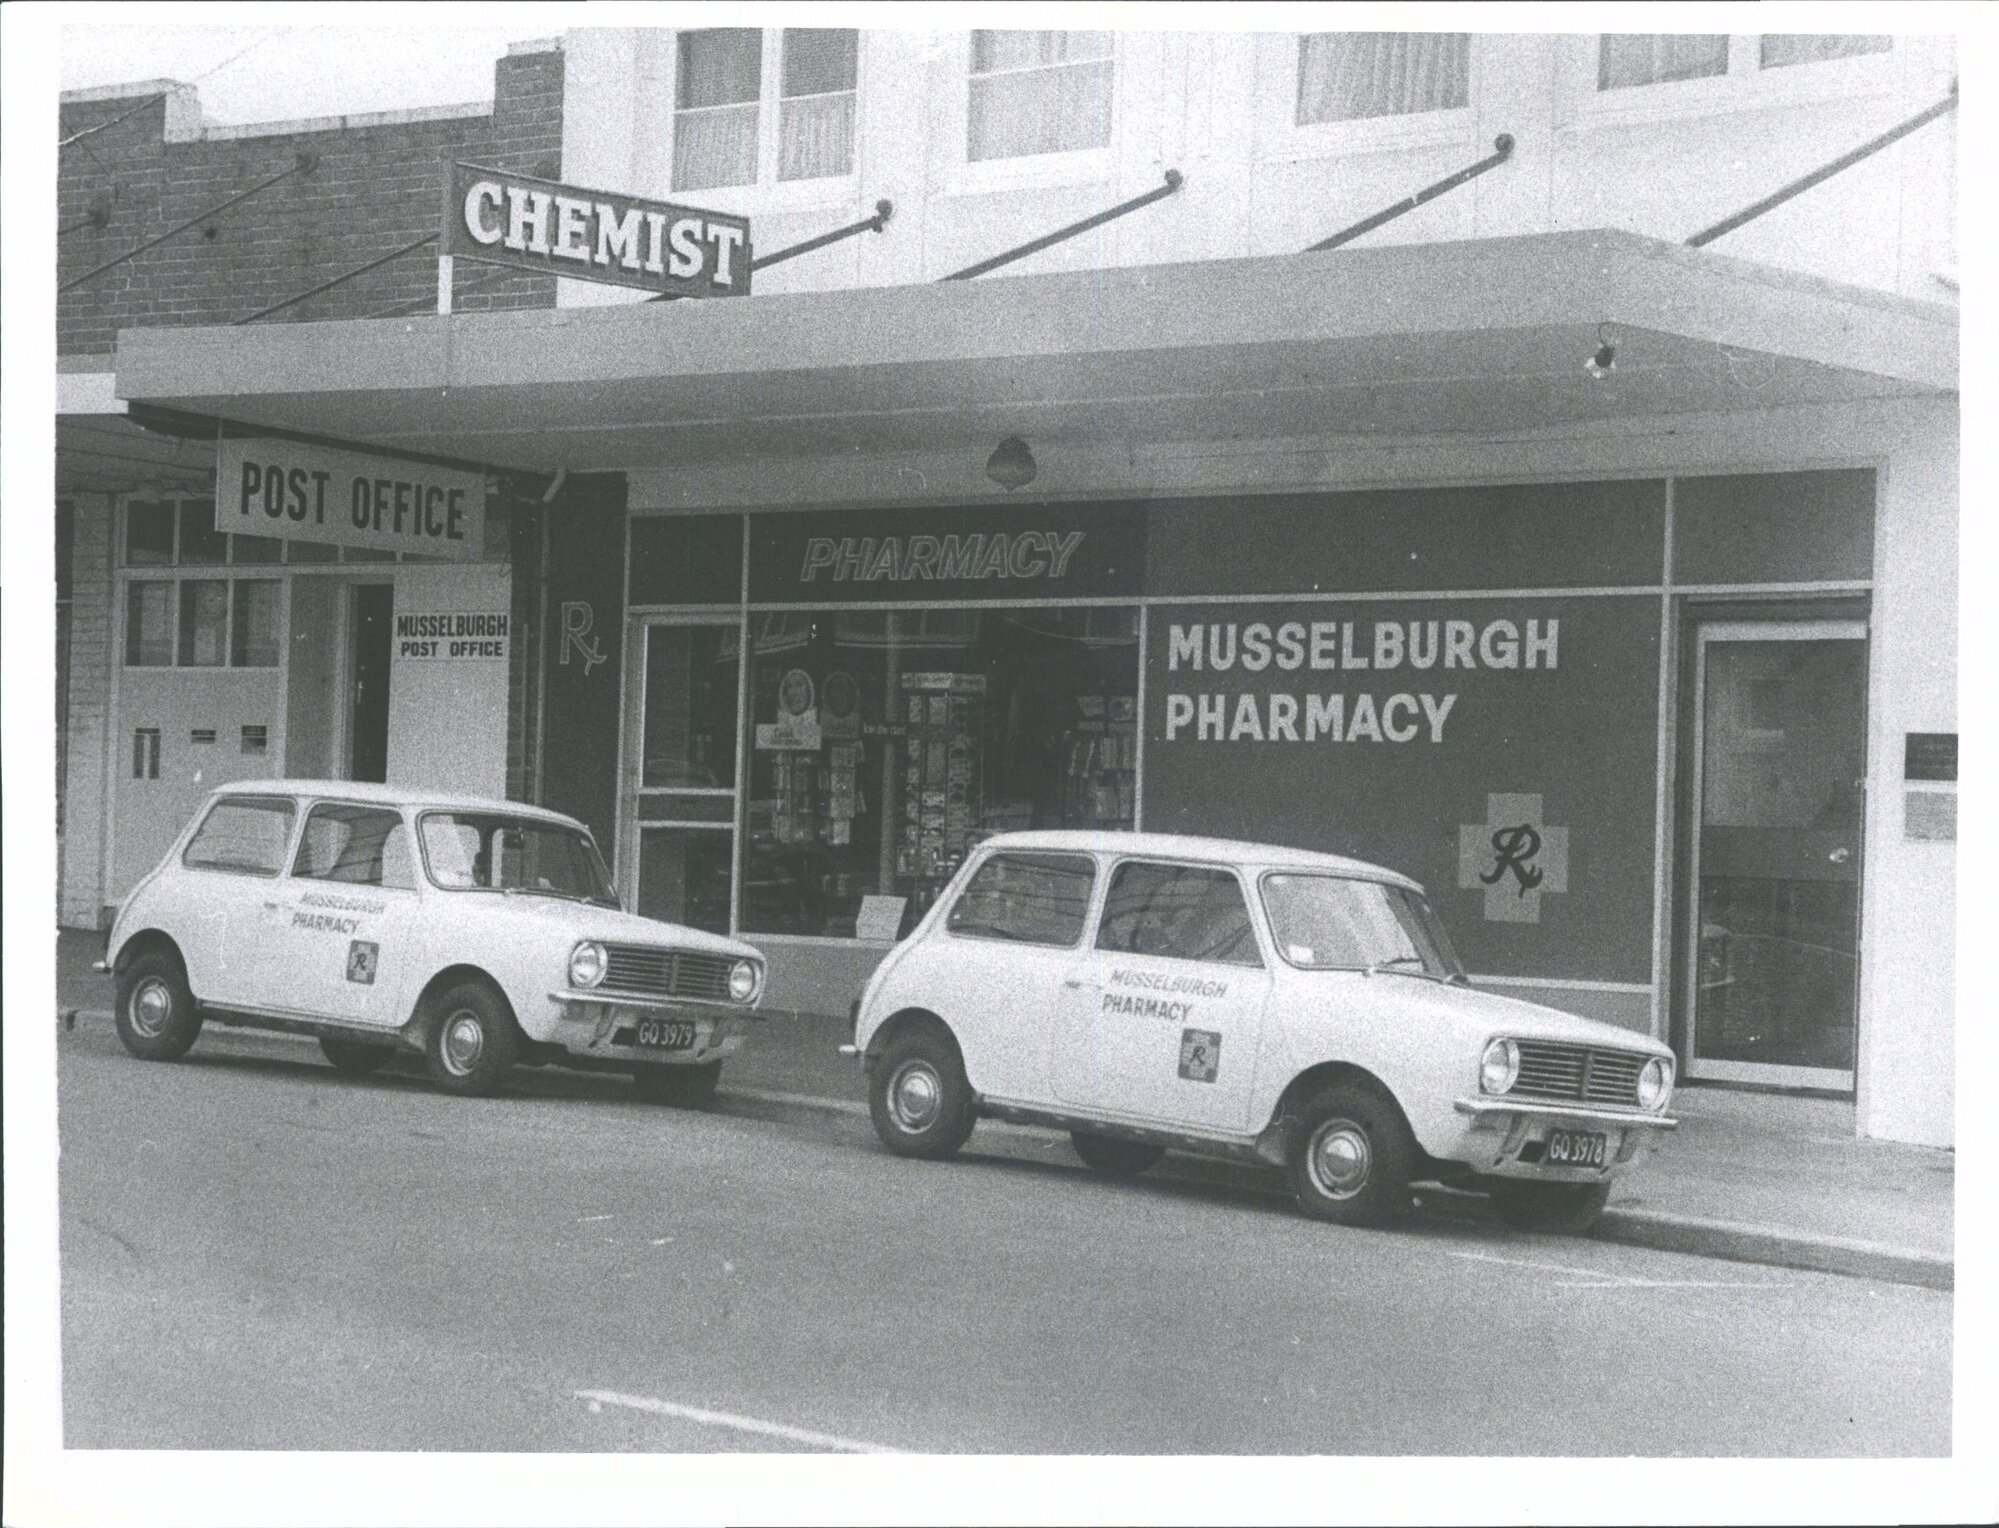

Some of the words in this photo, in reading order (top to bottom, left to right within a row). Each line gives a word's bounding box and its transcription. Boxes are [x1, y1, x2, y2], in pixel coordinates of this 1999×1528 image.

[464, 181, 744, 285] CHEMIST
[240, 461, 330, 524] POST
[351, 476, 465, 540] OFFICE
[800, 530, 1086, 582] PHARMACY
[397, 614, 508, 638] MUSSELBURGH
[401, 641, 438, 658] POST
[450, 640, 503, 658] OFFICE
[1168, 619, 1559, 672] MUSSELBURGH
[1166, 692, 1458, 744] PHARMACY
[292, 911, 360, 934] PHARMACY
[1109, 969, 1228, 998] MUSSELBURGH
[1102, 993, 1193, 1022] PHARMACY
[661, 1023, 693, 1046] 3979
[1571, 1134, 1603, 1163] 3978
